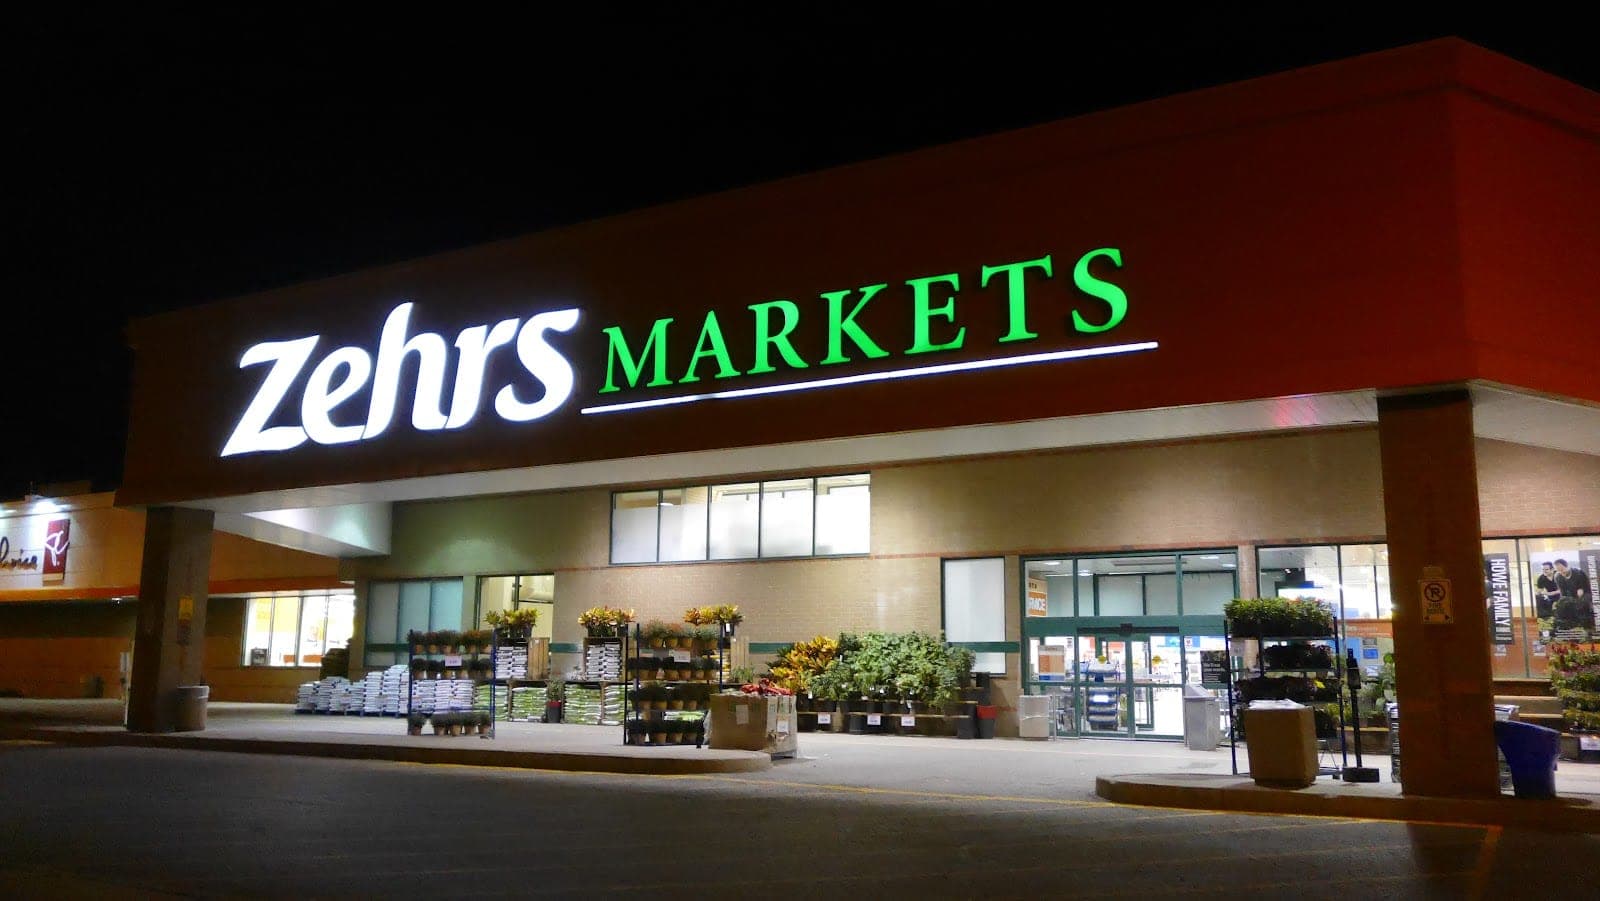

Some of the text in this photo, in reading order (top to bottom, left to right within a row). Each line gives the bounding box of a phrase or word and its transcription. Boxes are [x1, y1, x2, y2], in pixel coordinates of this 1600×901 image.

[219, 248, 1128, 457] Zehrs MARKETS
[1491, 558, 1508, 589] HOWE
[1493, 591, 1511, 626] FAMILY
